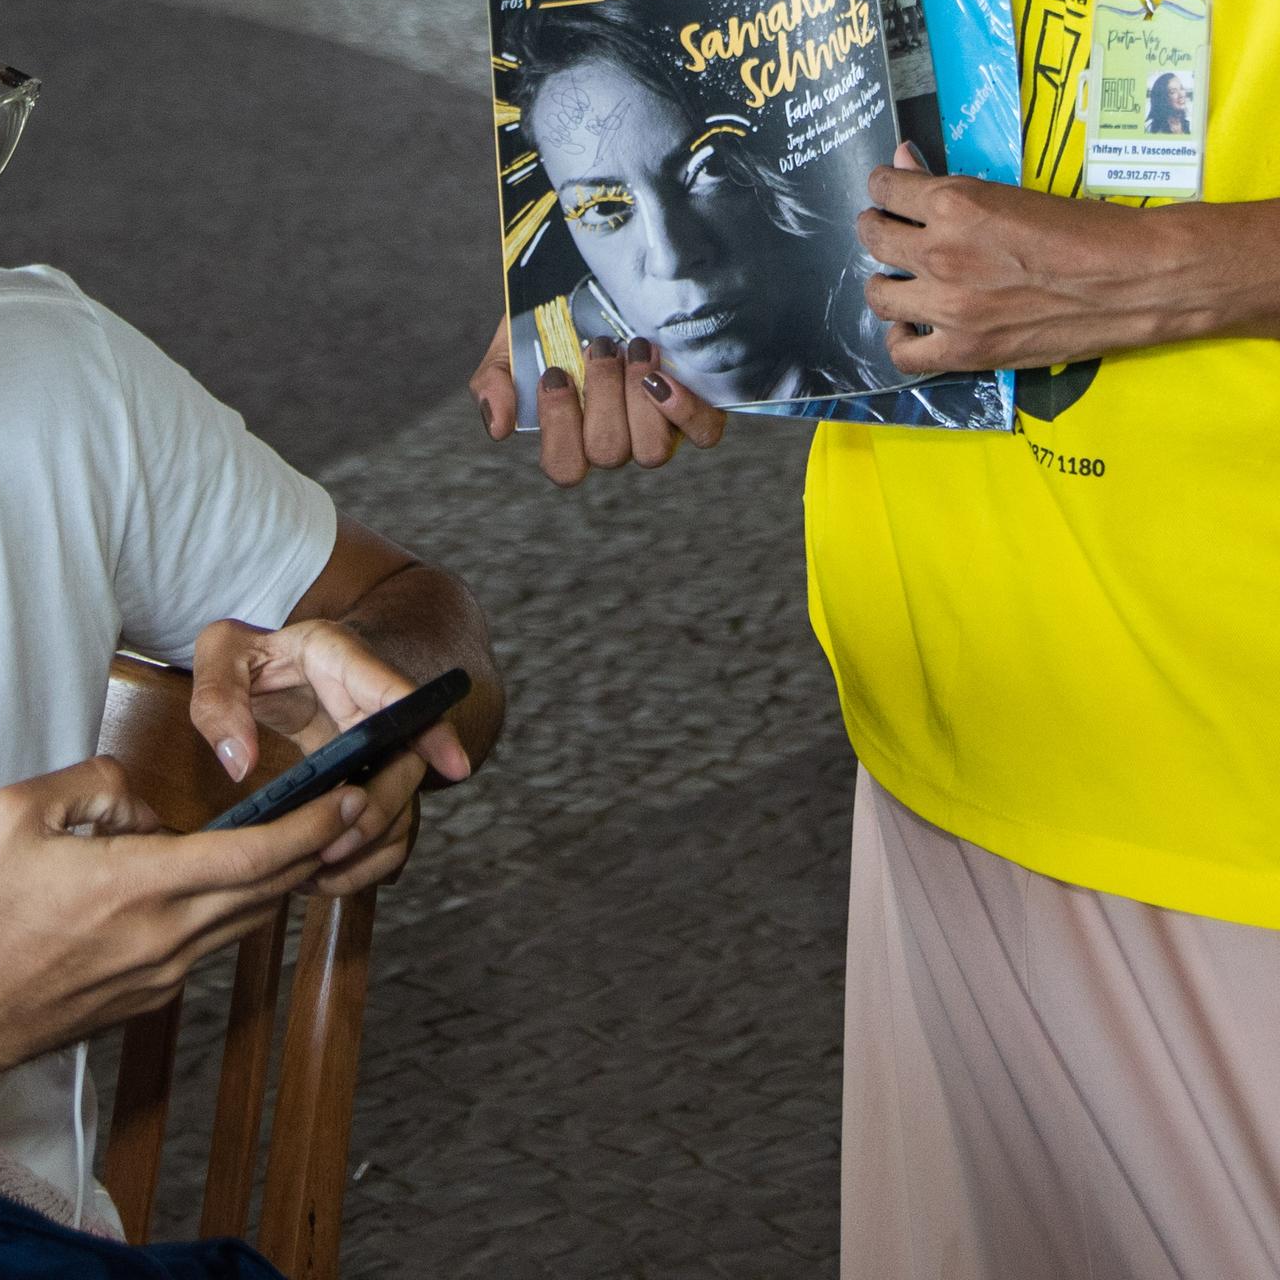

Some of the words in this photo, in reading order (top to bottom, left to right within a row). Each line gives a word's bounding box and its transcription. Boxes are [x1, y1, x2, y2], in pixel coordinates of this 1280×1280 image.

[785, 89, 823, 128] Fada
[823, 62, 865, 106] sensata
[1141, 145, 1197, 156] Vasconcellos
[779, 154, 794, 173] DJ
[1057, 455, 1106, 477] 1180
